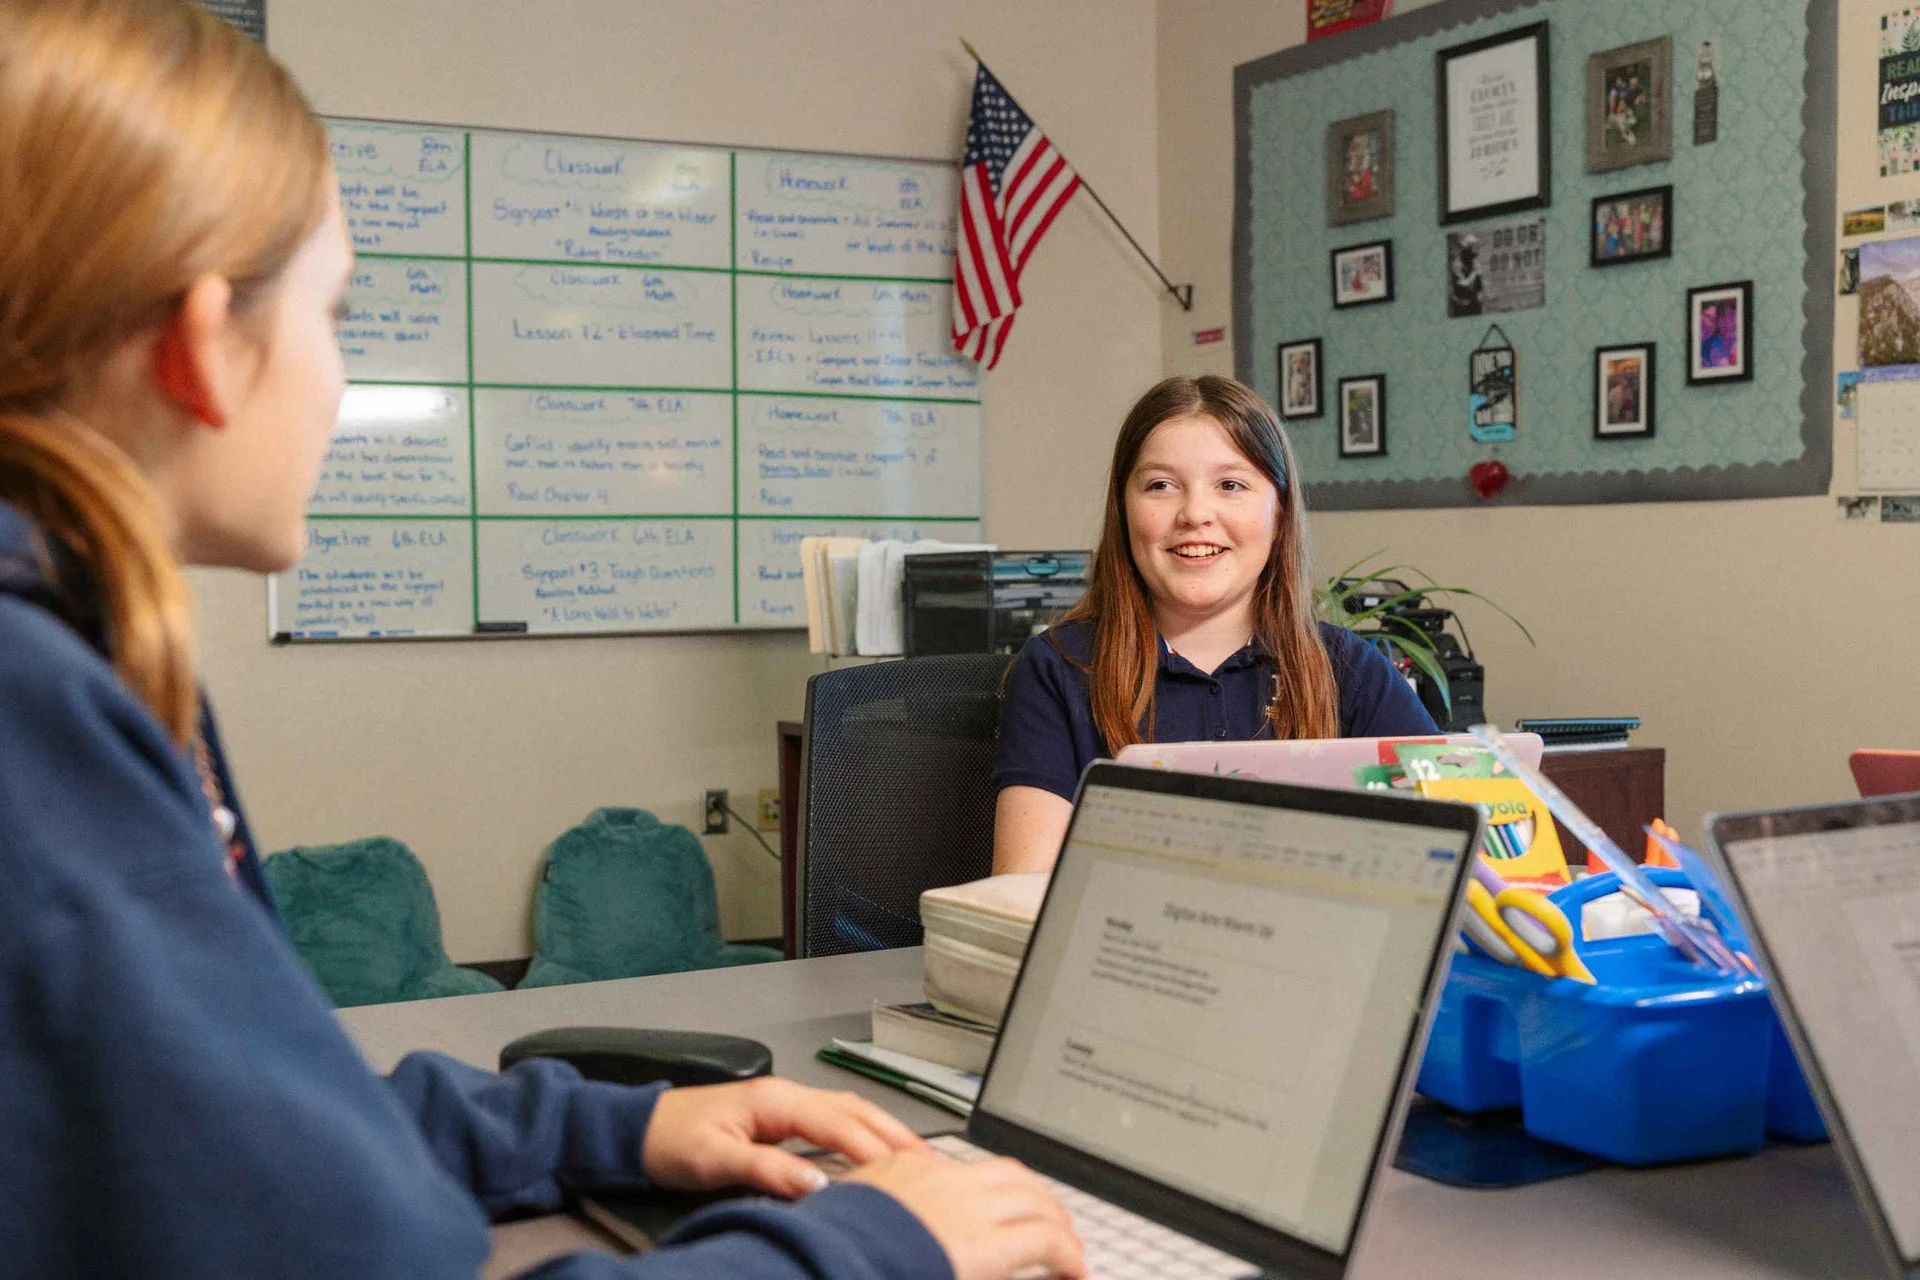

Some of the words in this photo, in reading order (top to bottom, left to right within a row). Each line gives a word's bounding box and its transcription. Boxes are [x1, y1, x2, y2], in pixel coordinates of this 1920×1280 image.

[1886, 56, 1920, 79] REA
[1880, 80, 1920, 105] Insp
[545, 147, 626, 175] Classwork
[780, 168, 848, 191] Homework
[549, 268, 622, 287] Classwork
[511, 317, 574, 341] Lesson
[582, 323, 604, 341] 12
[662, 527, 697, 546] ELA
[1409, 758, 1444, 781] 12
